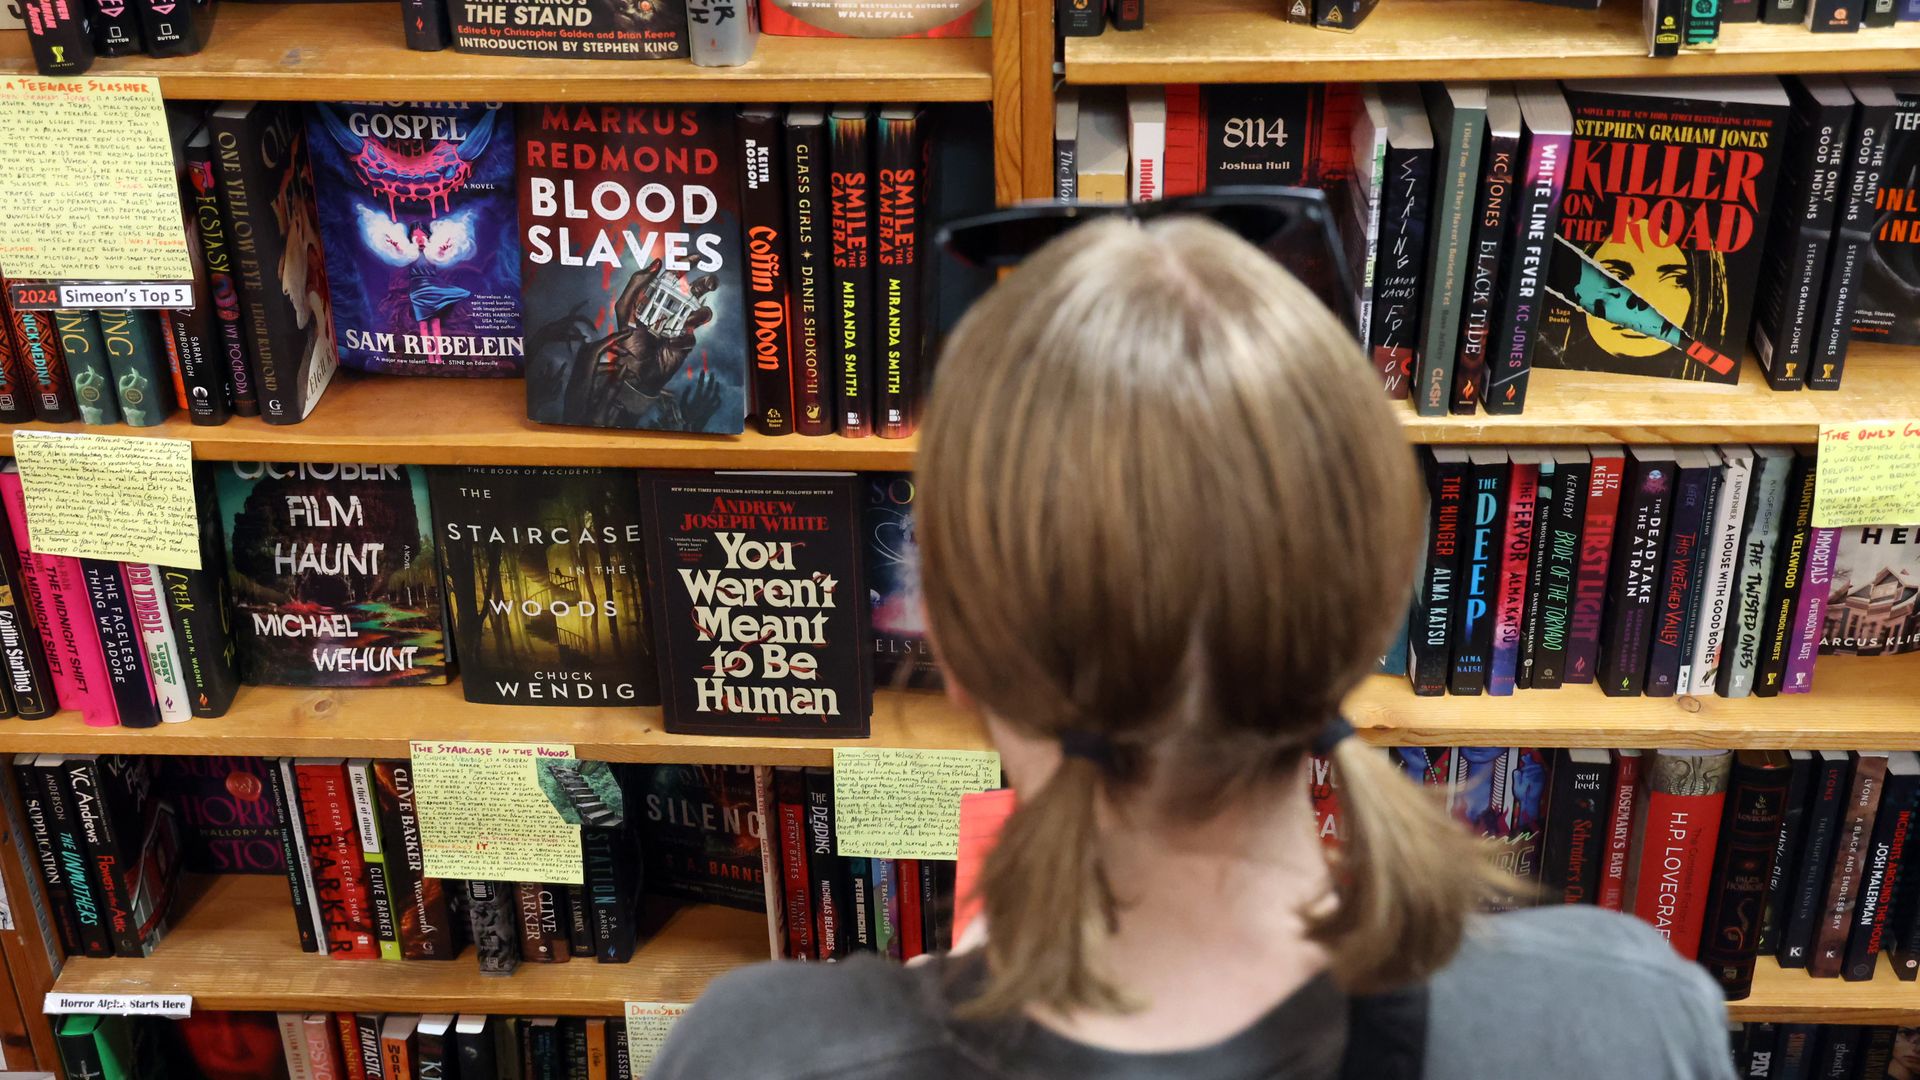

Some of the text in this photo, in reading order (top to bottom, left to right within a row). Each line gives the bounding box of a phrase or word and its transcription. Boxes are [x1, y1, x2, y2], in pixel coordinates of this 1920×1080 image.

[458, 26, 487, 35] Edited
[490, 27, 501, 36] by
[504, 28, 556, 39] Christopher
[560, 30, 594, 38] Golden
[645, 30, 676, 38] Keene
[466, 6, 592, 26] THE STAND
[838, 10, 914, 18] WHALEFALL
[460, 38, 678, 52] INTRODUCTION BY STEPHEN KING
[18, 79, 83, 92] TEENAGE
[88, 80, 150, 93] SLASHER
[349, 112, 466, 140] GOSPEL
[542, 106, 698, 136] MARKUS
[1223, 118, 1288, 148] 8114
[1575, 119, 1769, 148] STEPHEN GRAHAM JONES
[527, 141, 719, 175] REDMOND
[746, 139, 758, 190] ROSSON
[758, 147, 769, 183] KEITH
[1220, 161, 1290, 170] Joshua Hull
[1568, 139, 1765, 213] KILLER
[1807, 126, 1832, 220] GOOD INDIANS
[1823, 143, 1843, 203] THE ONLY
[218, 131, 263, 290] ONE YELLOW EYE
[531, 177, 718, 224] BLOOD
[797, 144, 812, 244] GLASS GIRLS
[845, 172, 867, 249] SMILE
[1564, 193, 1594, 216] ON
[196, 196, 230, 272] ECSTASY
[831, 172, 847, 268] CAMERAS
[1561, 217, 1608, 242] THE
[1609, 195, 1754, 254] ROAD
[528, 224, 723, 272] SLAVES
[848, 251, 857, 268] THE
[859, 250, 867, 268] FOR
[1465, 153, 1509, 355] KC JONES BLACK TIDE
[1509, 144, 1558, 368] WHITE LINE FEVER KC JONES
[19, 289, 57, 303] 2024
[66, 289, 183, 307] Simeon's Top 5
[749, 226, 782, 371] Coffin Moon
[1790, 243, 1816, 359] STEPHEN GRAHAM JONES
[22, 314, 49, 385] NICK MEDINA
[177, 322, 194, 377] PINBOROUGH
[190, 336, 202, 364] SARAH
[346, 329, 524, 356] SAM REBELEIN
[843, 281, 857, 397] MIRANDA SMITH
[227, 324, 248, 394] IVY POCHODA
[1821, 429, 1895, 440] THE ONLY
[460, 487, 492, 499] THE
[1478, 478, 1497, 490] THE
[285, 495, 364, 527] FILM
[680, 514, 830, 533] JOSEPH WHITE
[711, 496, 796, 515] ANDREW
[448, 523, 641, 545] STAIRCASE
[1510, 501, 1533, 561] FERVOR
[274, 543, 384, 576] HAUNT
[714, 532, 796, 570] You
[1427, 476, 1461, 645] THE HUNGER ALMA KATSU
[1466, 493, 1497, 645] DEEP
[1627, 506, 1648, 597] THE A TRAIN
[1639, 498, 1662, 604] THE DEAD TAKE
[1784, 533, 1804, 589] VELKWOOD
[569, 566, 627, 576] IN THE
[166, 572, 194, 612] CREEK
[490, 599, 619, 617] WOODS
[1705, 524, 1735, 664] A HOUSE WITH GOOD BONES
[1739, 541, 1764, 669] THE TWISTED ONES
[46, 566, 88, 694] THE MIDNIGHT SHIFT
[88, 568, 125, 684] THING WE ADORE
[103, 574, 136, 672] THE FACELESS
[132, 592, 164, 634] TINGLE
[252, 612, 358, 637] MICHAEL
[696, 606, 829, 644] Meant
[156, 642, 174, 684] LUCKY
[313, 647, 418, 672] WEHUNT
[534, 671, 593, 681] CHUCK
[710, 644, 818, 680] to Be
[496, 682, 635, 700] WENDIG
[694, 677, 840, 716] Human
[412, 743, 433, 753] THE
[438, 744, 492, 755] STAIRCASE
[537, 747, 569, 757] WOODS
[1574, 781, 1600, 790] leeds
[1576, 773, 1600, 781] scott
[811, 792, 827, 804] THE
[393, 768, 422, 871] CLIVE BARKER
[809, 806, 830, 854] DEADING
[1670, 812, 1689, 842] H.P.
[26, 799, 60, 885] SUPPLICATION
[60, 832, 75, 853] THE
[62, 849, 97, 926] UNMOTHERS
[1861, 843, 1889, 926] JOSH MALERMAN
[1868, 811, 1910, 954] INCIDENTS AROUND THE HOUSE
[821, 879, 836, 951] NICHOLAS BELARDES
[60, 998, 95, 1009] Horror
[129, 999, 159, 1010] Starts
[162, 1000, 186, 1010] Here
